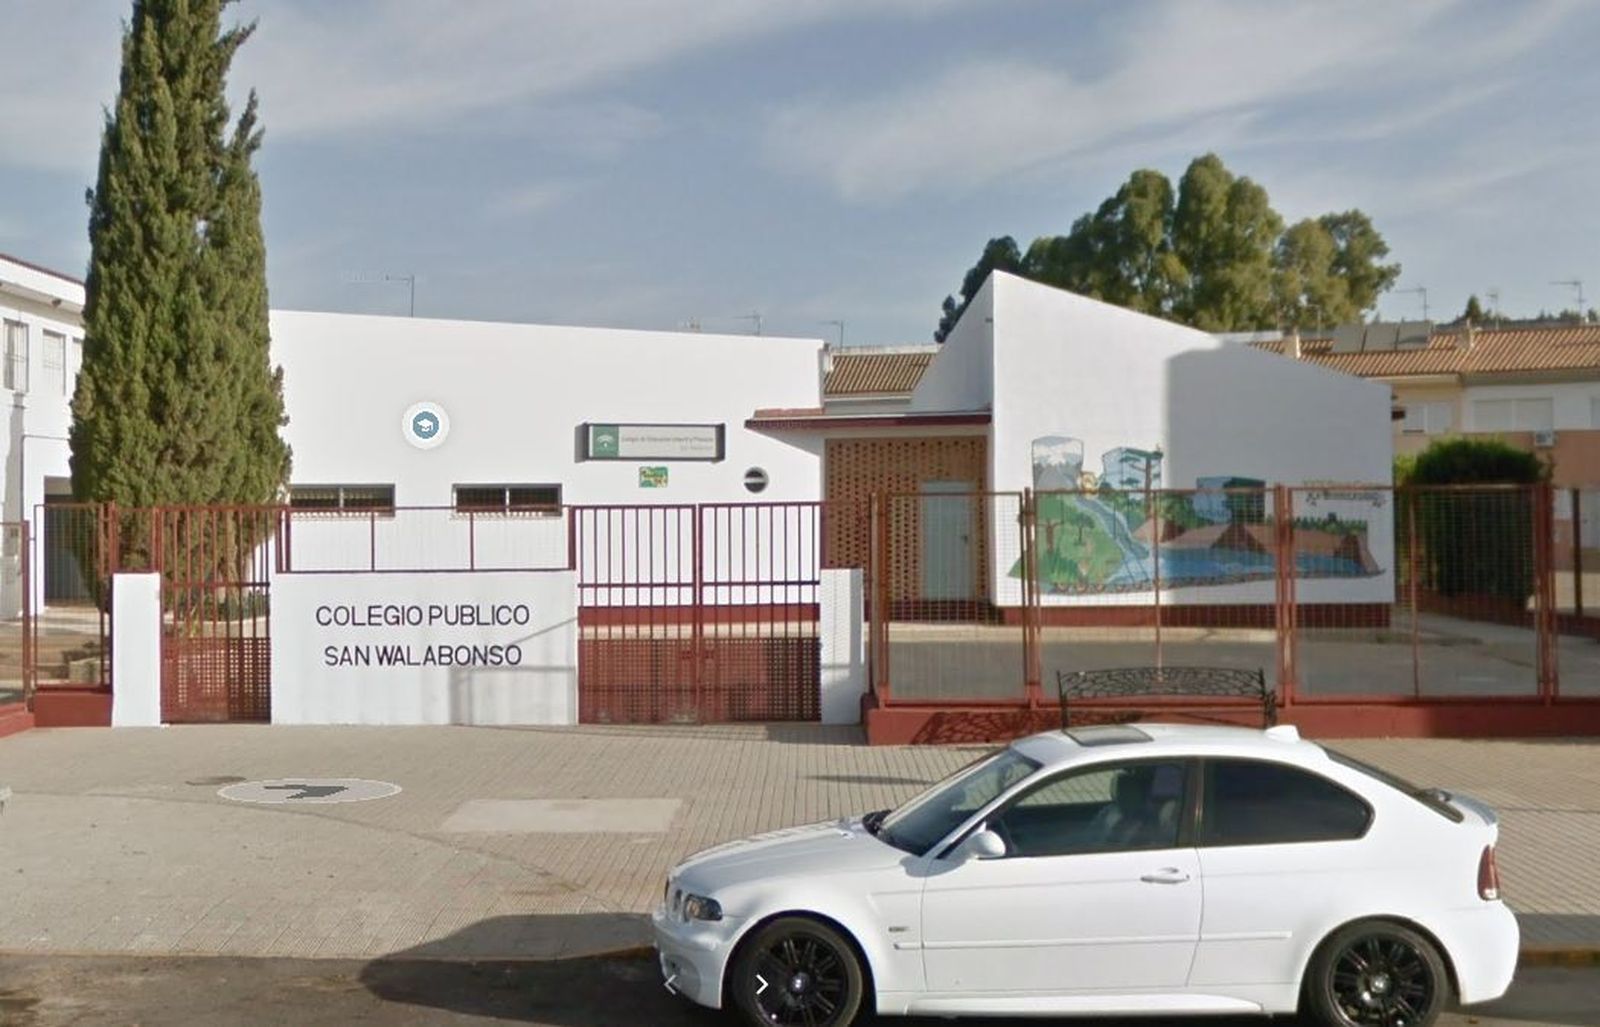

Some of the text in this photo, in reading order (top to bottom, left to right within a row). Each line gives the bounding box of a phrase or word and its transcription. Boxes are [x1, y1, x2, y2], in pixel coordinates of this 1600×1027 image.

[315, 604, 531, 627] COLEGIO PUBLICO
[323, 644, 523, 667] SAN WALABONSO
